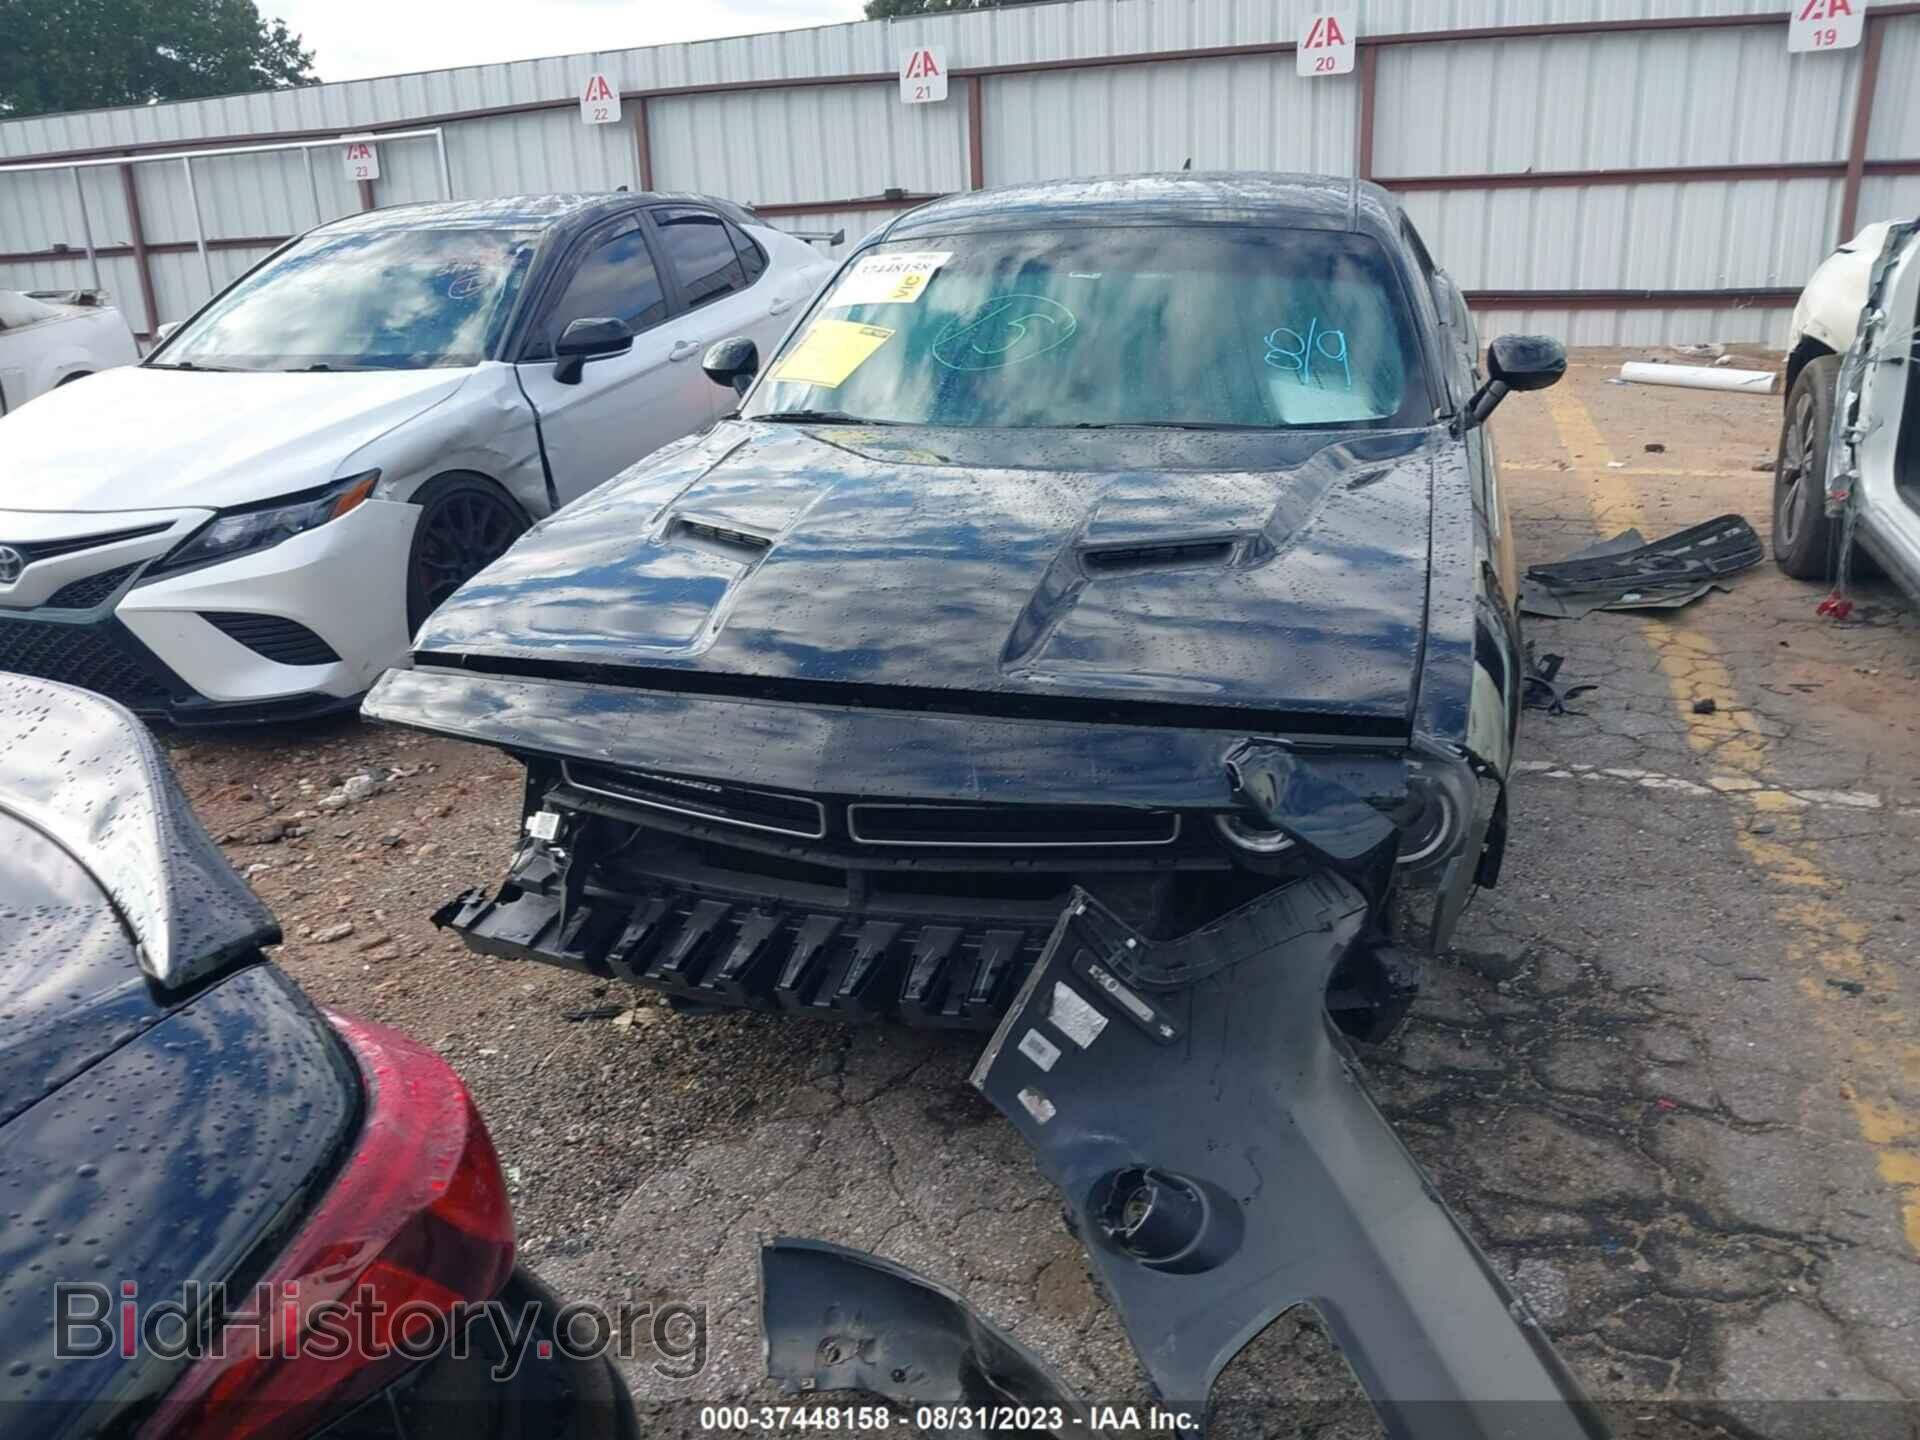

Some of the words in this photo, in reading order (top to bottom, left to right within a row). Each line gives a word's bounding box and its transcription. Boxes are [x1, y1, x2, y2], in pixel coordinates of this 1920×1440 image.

[1814, 29, 1836, 46] 19
[1315, 56, 1335, 72] 20
[915, 86, 930, 99] 21
[593, 108, 608, 121] 22
[355, 166, 368, 177] 23
[1264, 317, 1352, 390] 8/9
